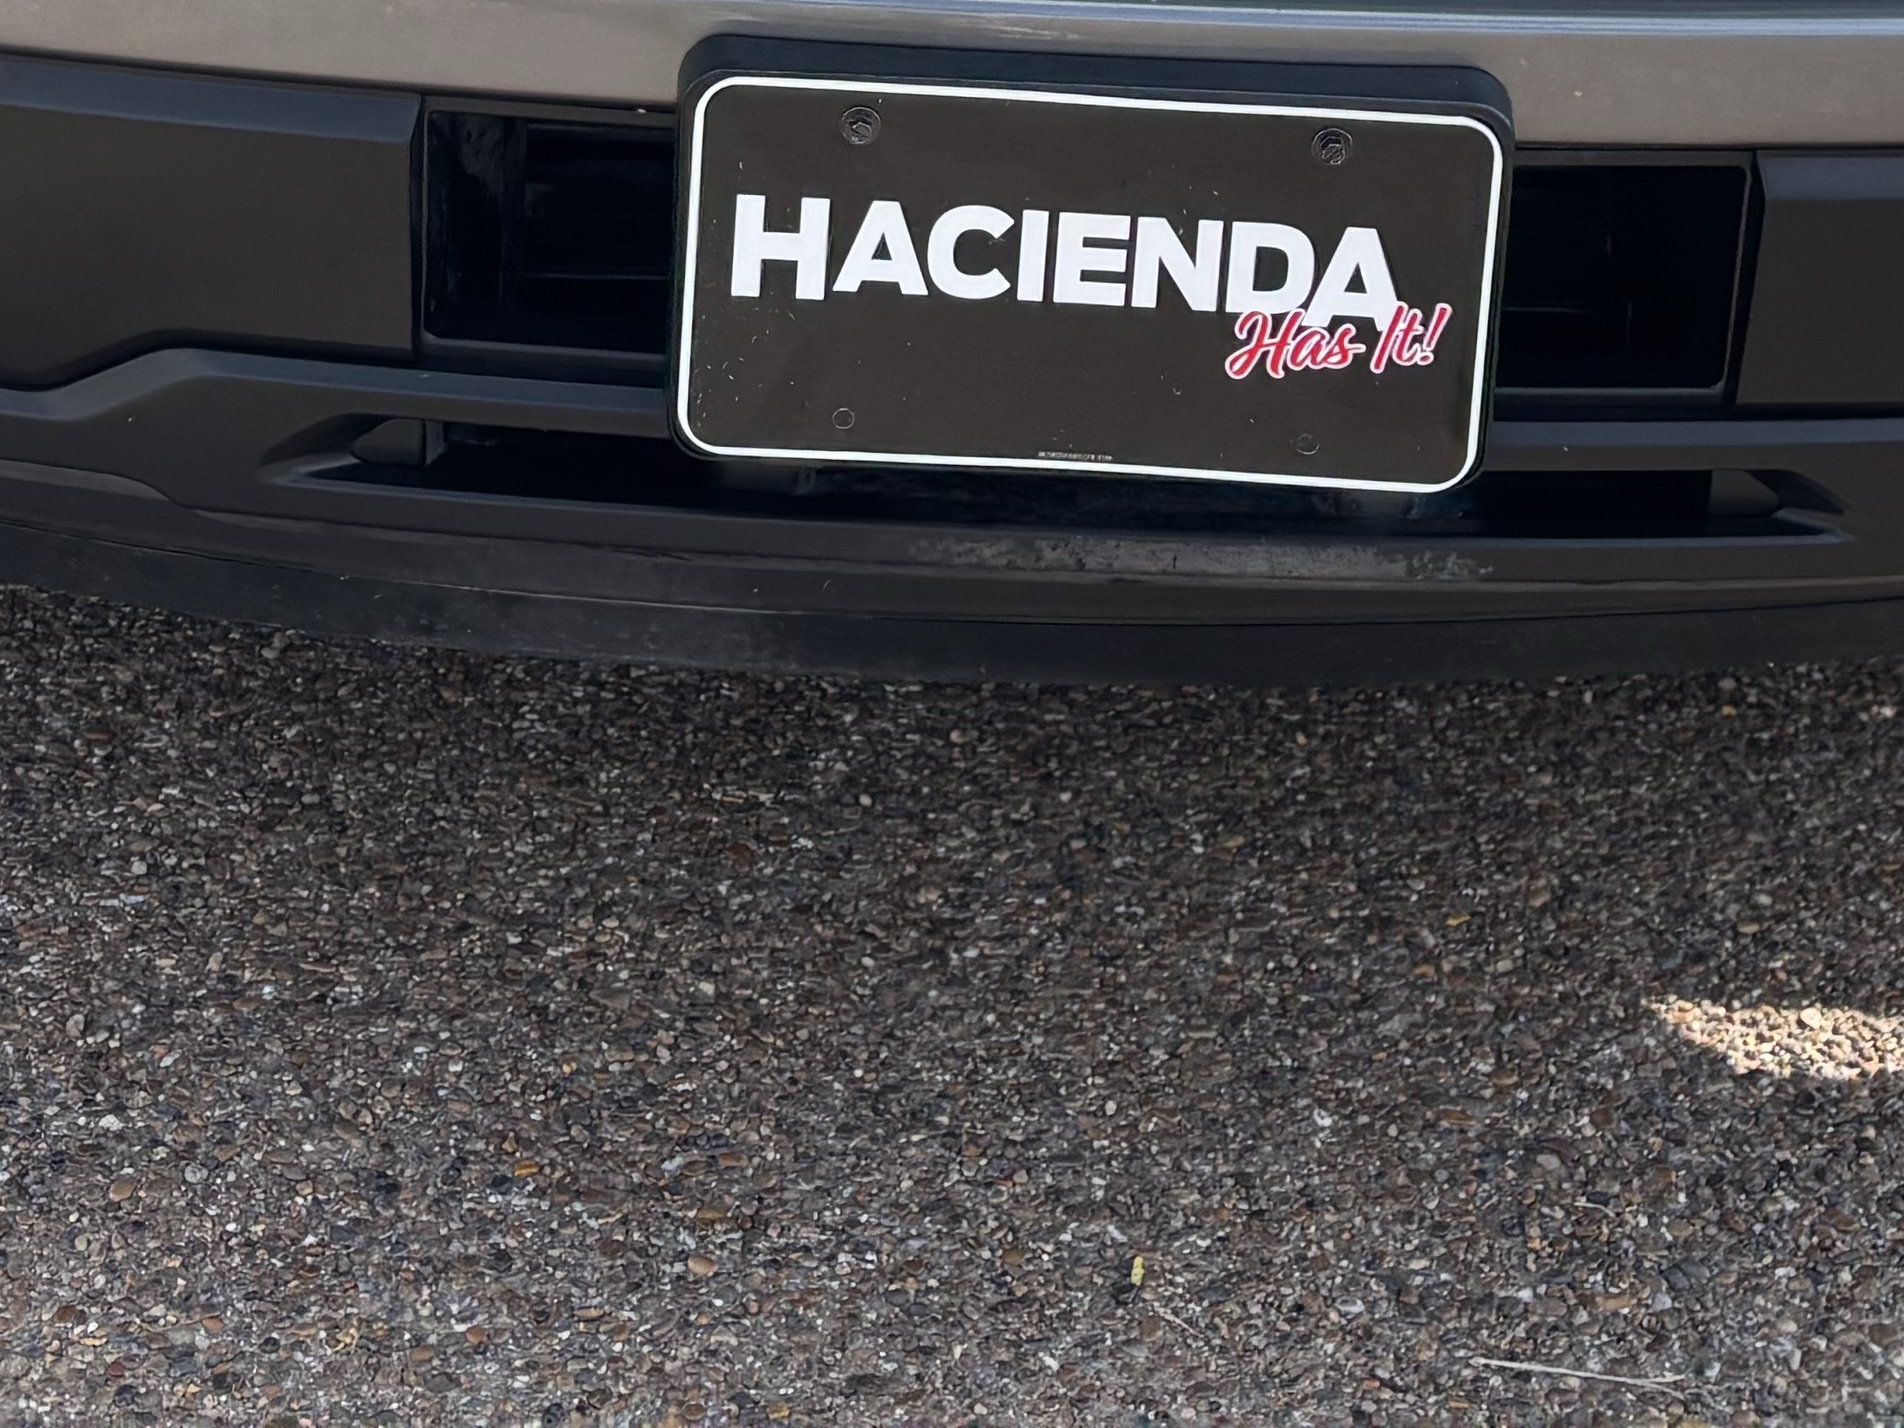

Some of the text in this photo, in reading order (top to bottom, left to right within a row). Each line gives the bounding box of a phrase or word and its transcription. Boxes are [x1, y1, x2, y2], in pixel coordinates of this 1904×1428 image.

[729, 193, 1400, 332] HACIENDA
[1225, 301, 1453, 380] Has It!
